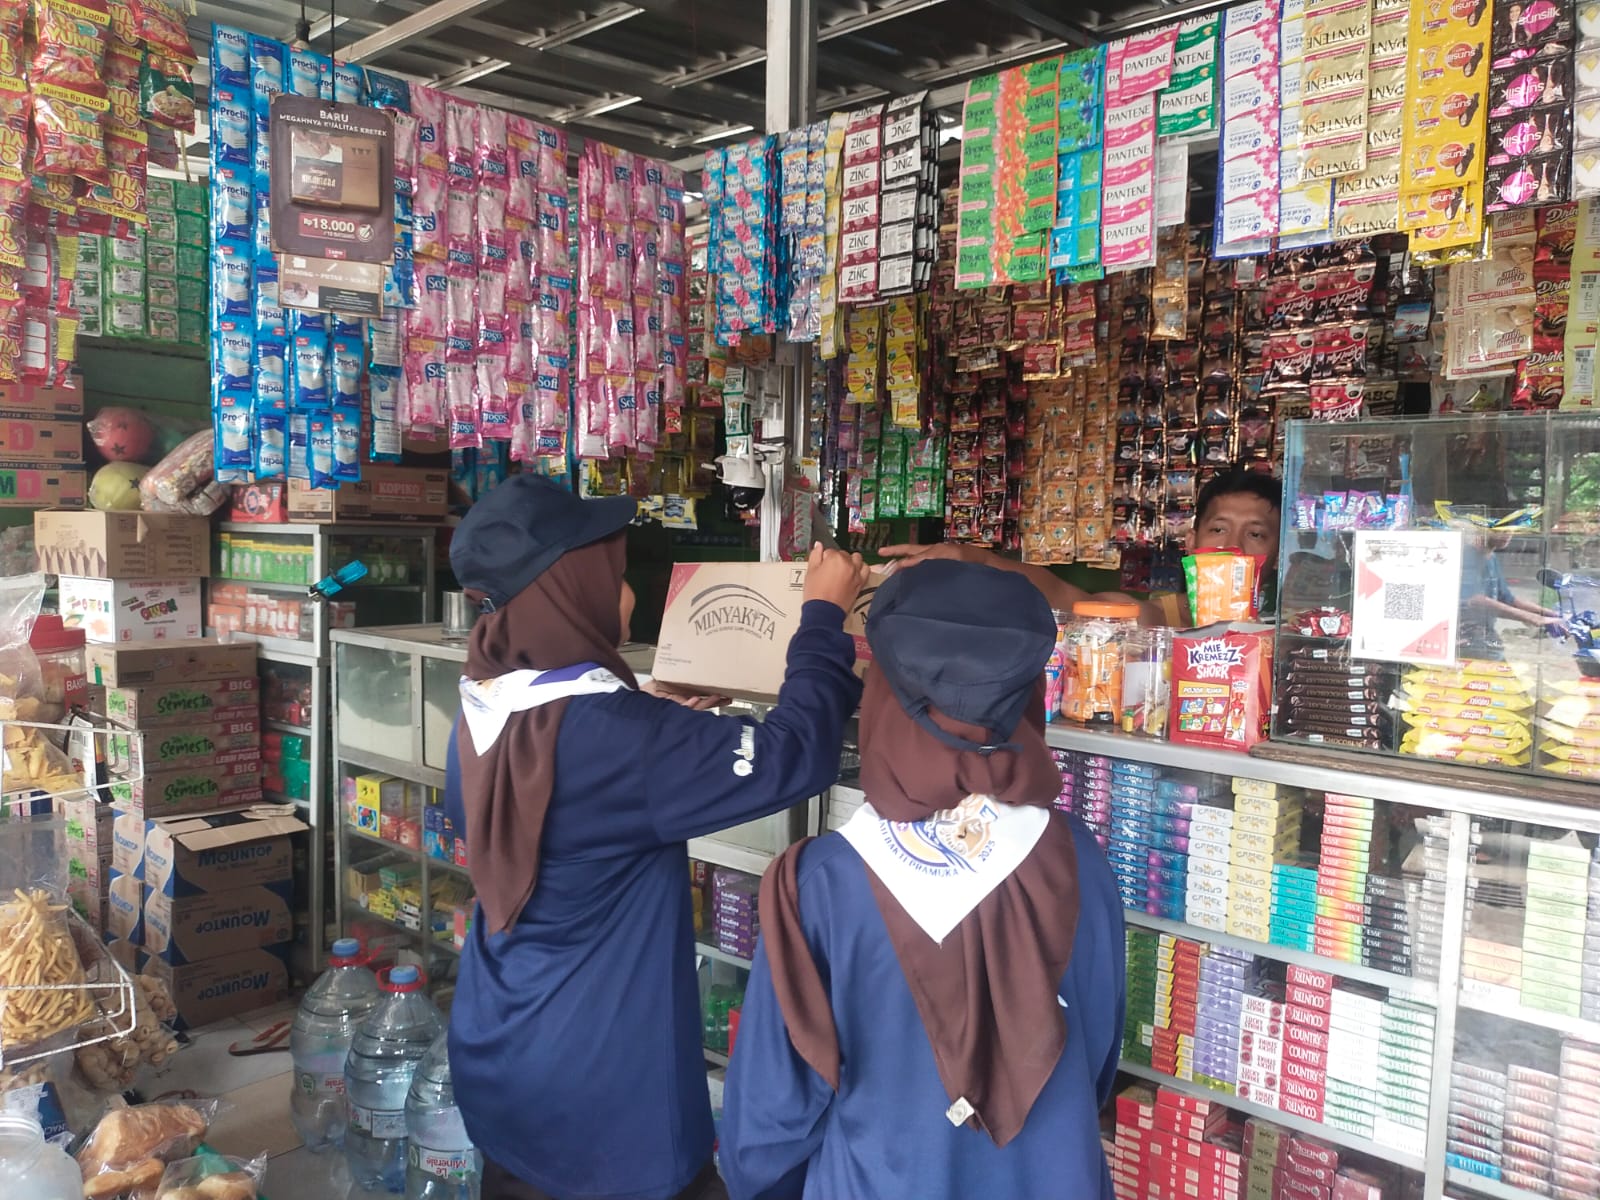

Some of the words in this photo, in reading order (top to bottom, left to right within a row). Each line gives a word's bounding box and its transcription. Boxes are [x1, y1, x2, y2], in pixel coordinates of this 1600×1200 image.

[1517, 7, 1561, 25] sunsilk
[217, 30, 247, 46] Proclin
[1306, 24, 1367, 50] PANTENE
[1124, 52, 1170, 72] PANTENE
[1304, 69, 1365, 92] PANTENE
[1501, 81, 1545, 98] sunsilk
[1161, 91, 1210, 110] PANTENE
[220, 106, 249, 120] Proclin
[320, 110, 349, 123] BARU
[1108, 104, 1152, 124] PANTENE
[279, 114, 322, 126] MEGAHNYA
[360, 127, 387, 136] KRETEK
[891, 123, 912, 138] ZINC
[1303, 114, 1364, 137] PANTENE
[850, 134, 871, 149] ZINC
[1499, 131, 1543, 148] sunsilk
[1107, 145, 1150, 162] PANTENE
[893, 156, 914, 171] ZINC
[1301, 158, 1361, 180] PANTENE
[849, 168, 871, 182] ZINC
[221, 182, 250, 197] Proclin
[1338, 172, 1399, 194] PANTENE
[1496, 178, 1540, 197] sunsilk
[1106, 185, 1149, 201] PANTENE
[848, 201, 870, 216] ZINC
[1106, 224, 1148, 240] PANTENE
[1336, 217, 1398, 236] PANTENE
[848, 235, 869, 249] ZINC
[847, 267, 869, 282] ZINC
[222, 336, 250, 349] Proclin
[1525, 351, 1564, 367] Drink
[1364, 391, 1395, 401] ABC
[222, 412, 250, 423] Proclin
[1360, 435, 1391, 449] ABC
[378, 483, 420, 495] KOPIKO
[795, 571, 802, 584] 7
[694, 606, 776, 641] MINYAKITA
[1203, 644, 1221, 652] MIE
[1190, 649, 1239, 664] KREMEZZ
[1196, 665, 1229, 679] SHORR
[229, 681, 252, 691] BIG
[158, 698, 213, 715] Semesta
[230, 723, 253, 734] BIG
[160, 741, 215, 759] Semesta
[234, 763, 256, 774] BIG
[164, 783, 219, 802] Semesta
[1241, 798, 1271, 809] CAMEL
[1197, 807, 1226, 818] CAMEL
[1239, 816, 1269, 827] CAMEL
[1194, 825, 1224, 837] CAMEL
[1237, 833, 1267, 845] CAMEL
[199, 845, 273, 867] MOUNTOP
[978, 840, 996, 862] 2025
[1194, 843, 1223, 855] CAMEL
[1236, 851, 1265, 862] CAMEL
[908, 860, 960, 879] PRAMUKA
[1320, 878, 1336, 886] ESSE
[1319, 888, 1334, 896] ESSE
[1371, 888, 1385, 896] ESSE
[1191, 895, 1221, 906] CAMEL
[1191, 912, 1220, 923] CAMEL
[1233, 904, 1263, 916] CAMEL
[195, 908, 271, 934] MOUNTOP
[1232, 922, 1262, 932] CAMEL
[1318, 918, 1333, 926] ESSE
[1317, 928, 1333, 936] ESSE
[1367, 929, 1381, 937] ESSE
[1317, 938, 1332, 946] ESSE
[1366, 940, 1381, 948] ESSE
[1317, 949, 1332, 957] ESSE
[197, 971, 269, 1000] MOUNTOP
[1294, 971, 1325, 988] COUNTRY
[1247, 997, 1265, 1009] LUCKY
[1293, 990, 1324, 1008] COUNTRY
[1245, 1016, 1263, 1027] LUCKY
[1292, 1010, 1323, 1027] COUNTRY
[1290, 1028, 1321, 1046] COUNTRY
[1259, 1044, 1277, 1054] LUCKY
[1289, 1046, 1320, 1064] COUNTRY
[1242, 1067, 1260, 1077] LUCKY
[1288, 1063, 1318, 1083] COUNTRY
[1286, 1082, 1317, 1100] COUNTRY
[1285, 1101, 1316, 1118] COUNTRY
[426, 1156, 467, 1168] Minerale
